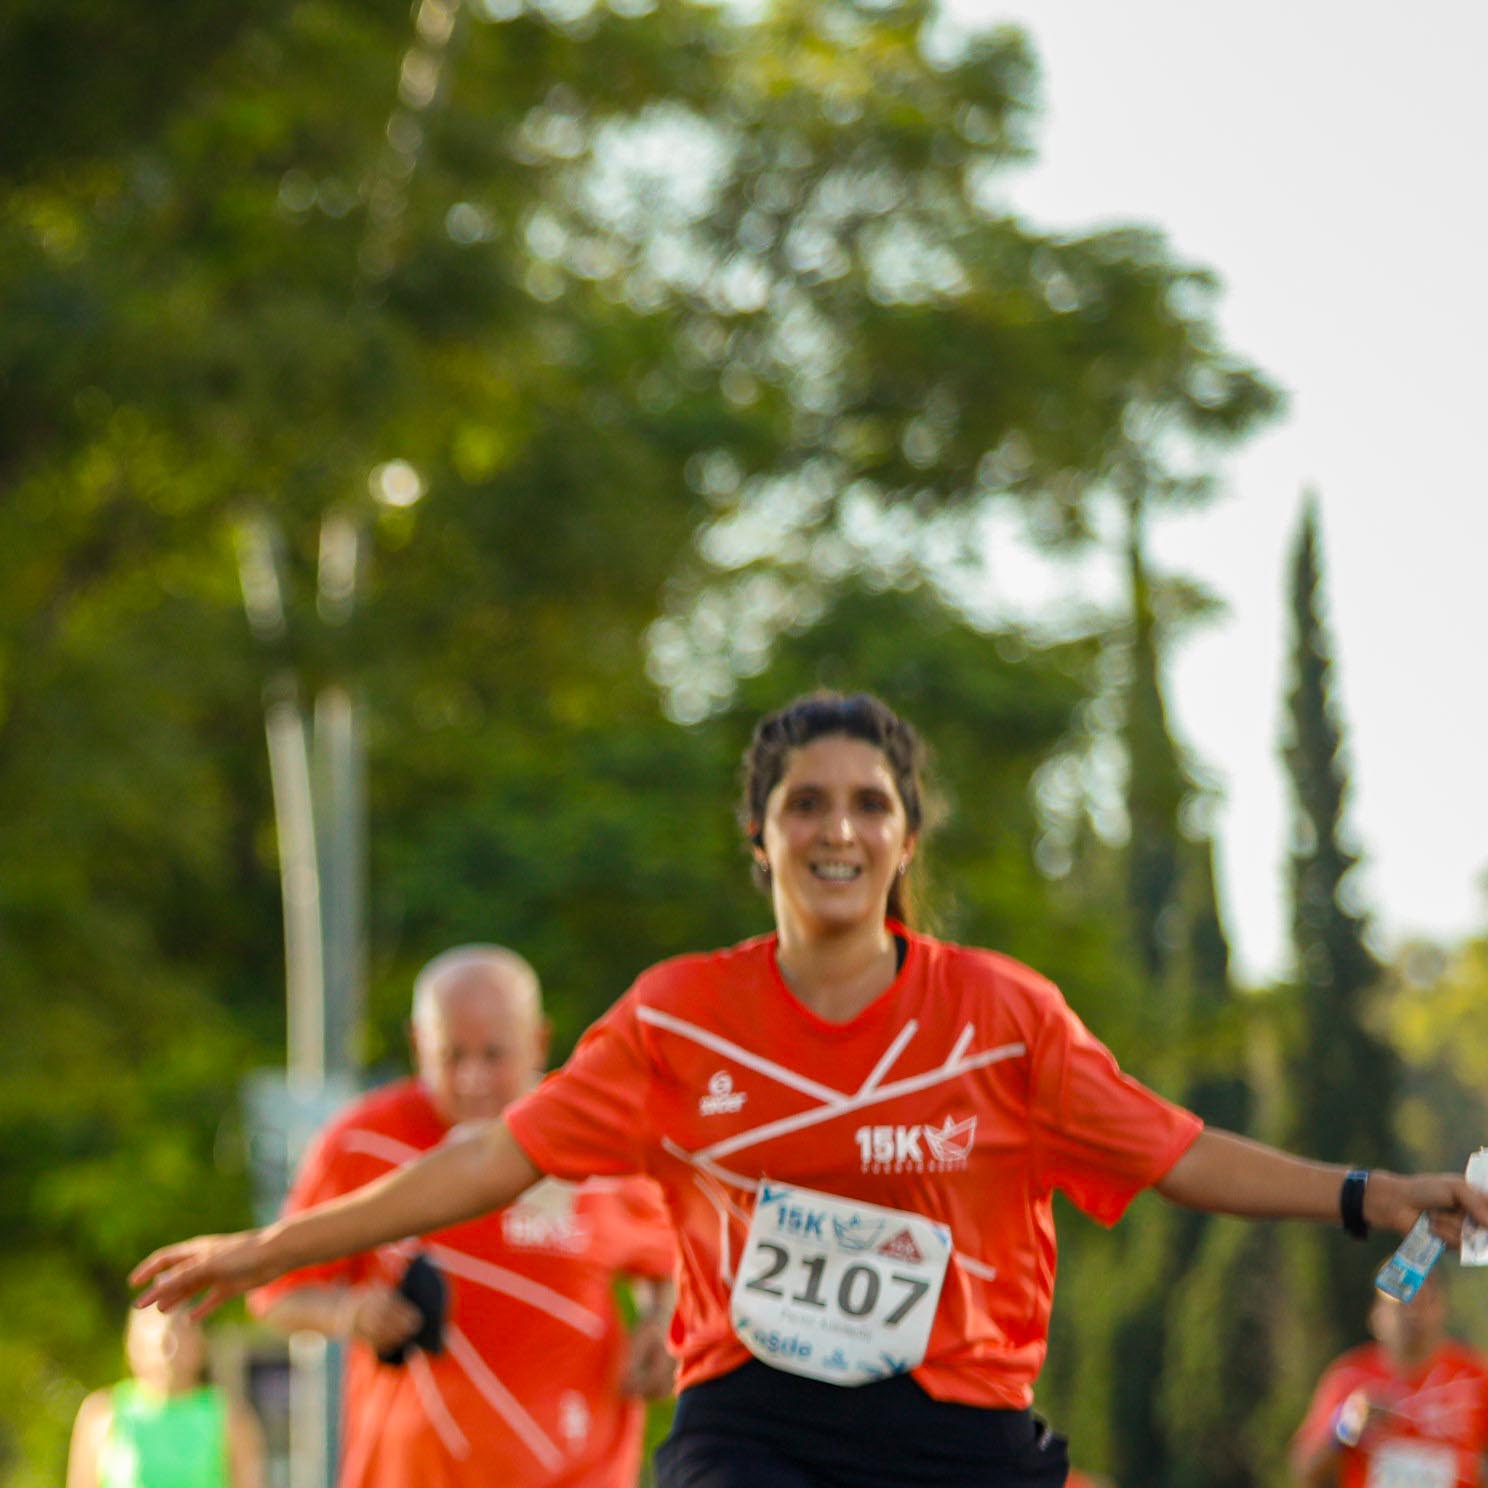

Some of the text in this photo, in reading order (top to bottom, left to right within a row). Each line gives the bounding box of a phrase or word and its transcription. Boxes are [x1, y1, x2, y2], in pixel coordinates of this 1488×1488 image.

[855, 1125, 924, 1165] 15K
[779, 1205, 824, 1236] 15K
[745, 1241, 931, 1328] 2107
